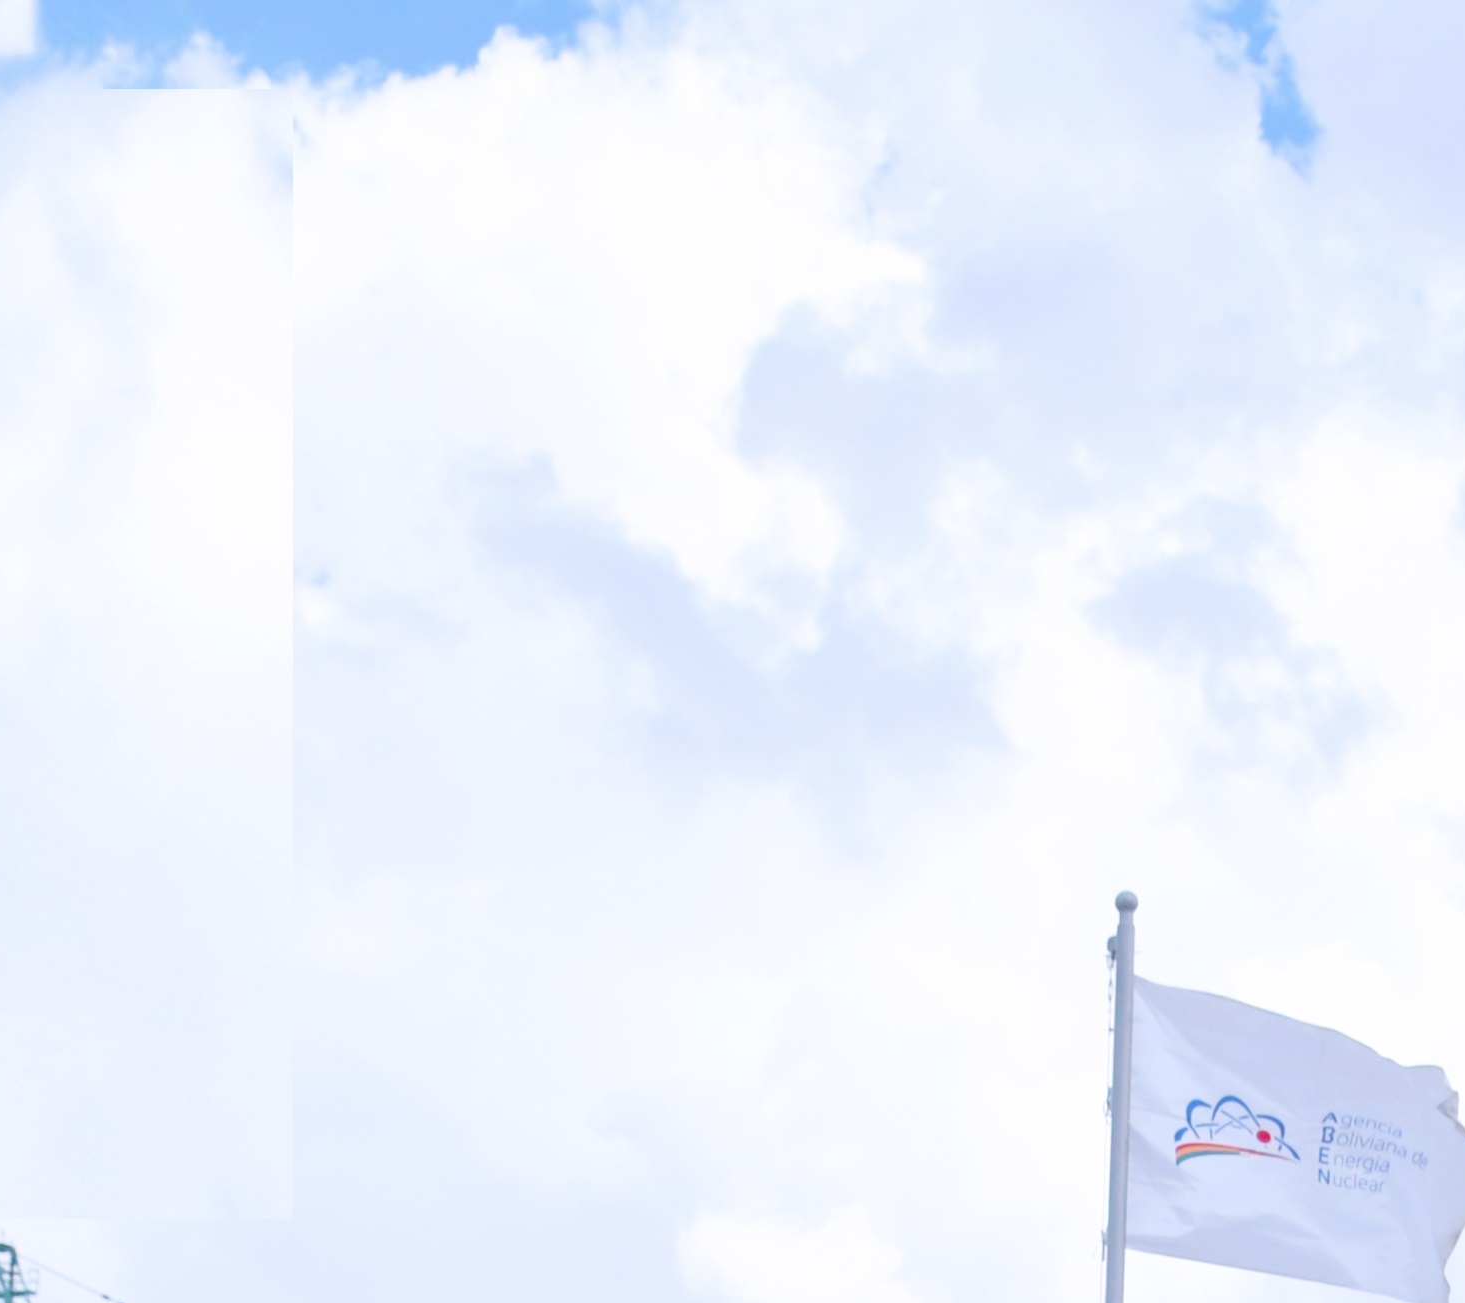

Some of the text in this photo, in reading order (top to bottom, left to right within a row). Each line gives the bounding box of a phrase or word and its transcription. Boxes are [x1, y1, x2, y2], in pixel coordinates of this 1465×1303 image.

[1322, 1112, 1402, 1138] Agencia
[1318, 1146, 1390, 1174] Energía
[1321, 1126, 1428, 1170] Boliviana de
[1318, 1168, 1385, 1193] Nuclear
